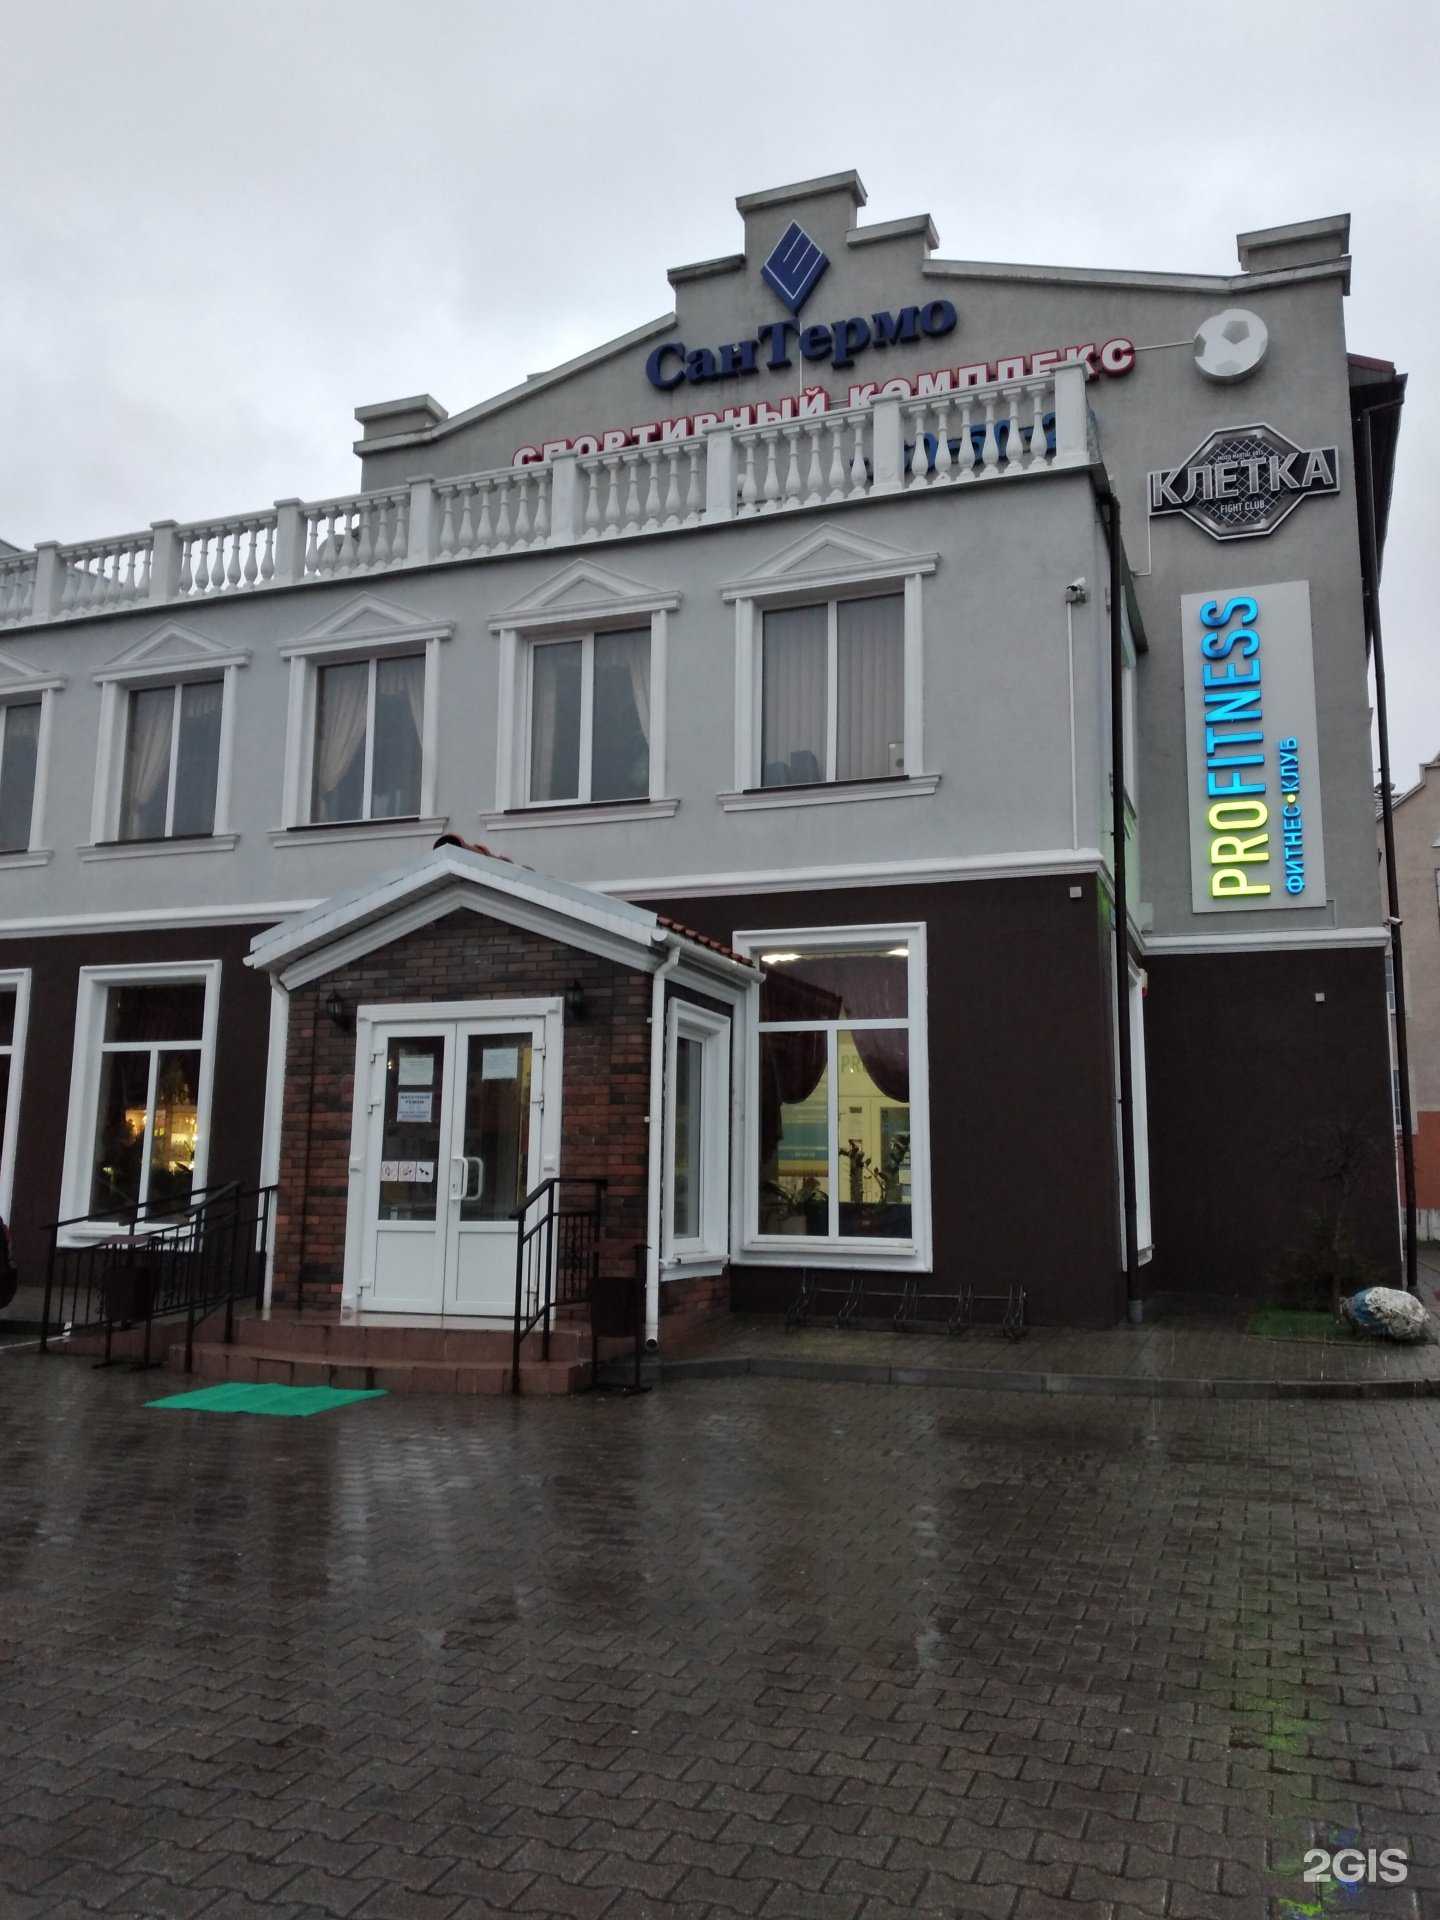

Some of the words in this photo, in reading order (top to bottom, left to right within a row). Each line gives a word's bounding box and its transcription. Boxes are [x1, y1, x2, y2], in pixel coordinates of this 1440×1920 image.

[645, 299, 957, 391] СанТермо
[1153, 450, 1334, 507] КЛЕТКА
[1220, 502, 1242, 513] FIGHT
[1244, 500, 1265, 510] CLUB
